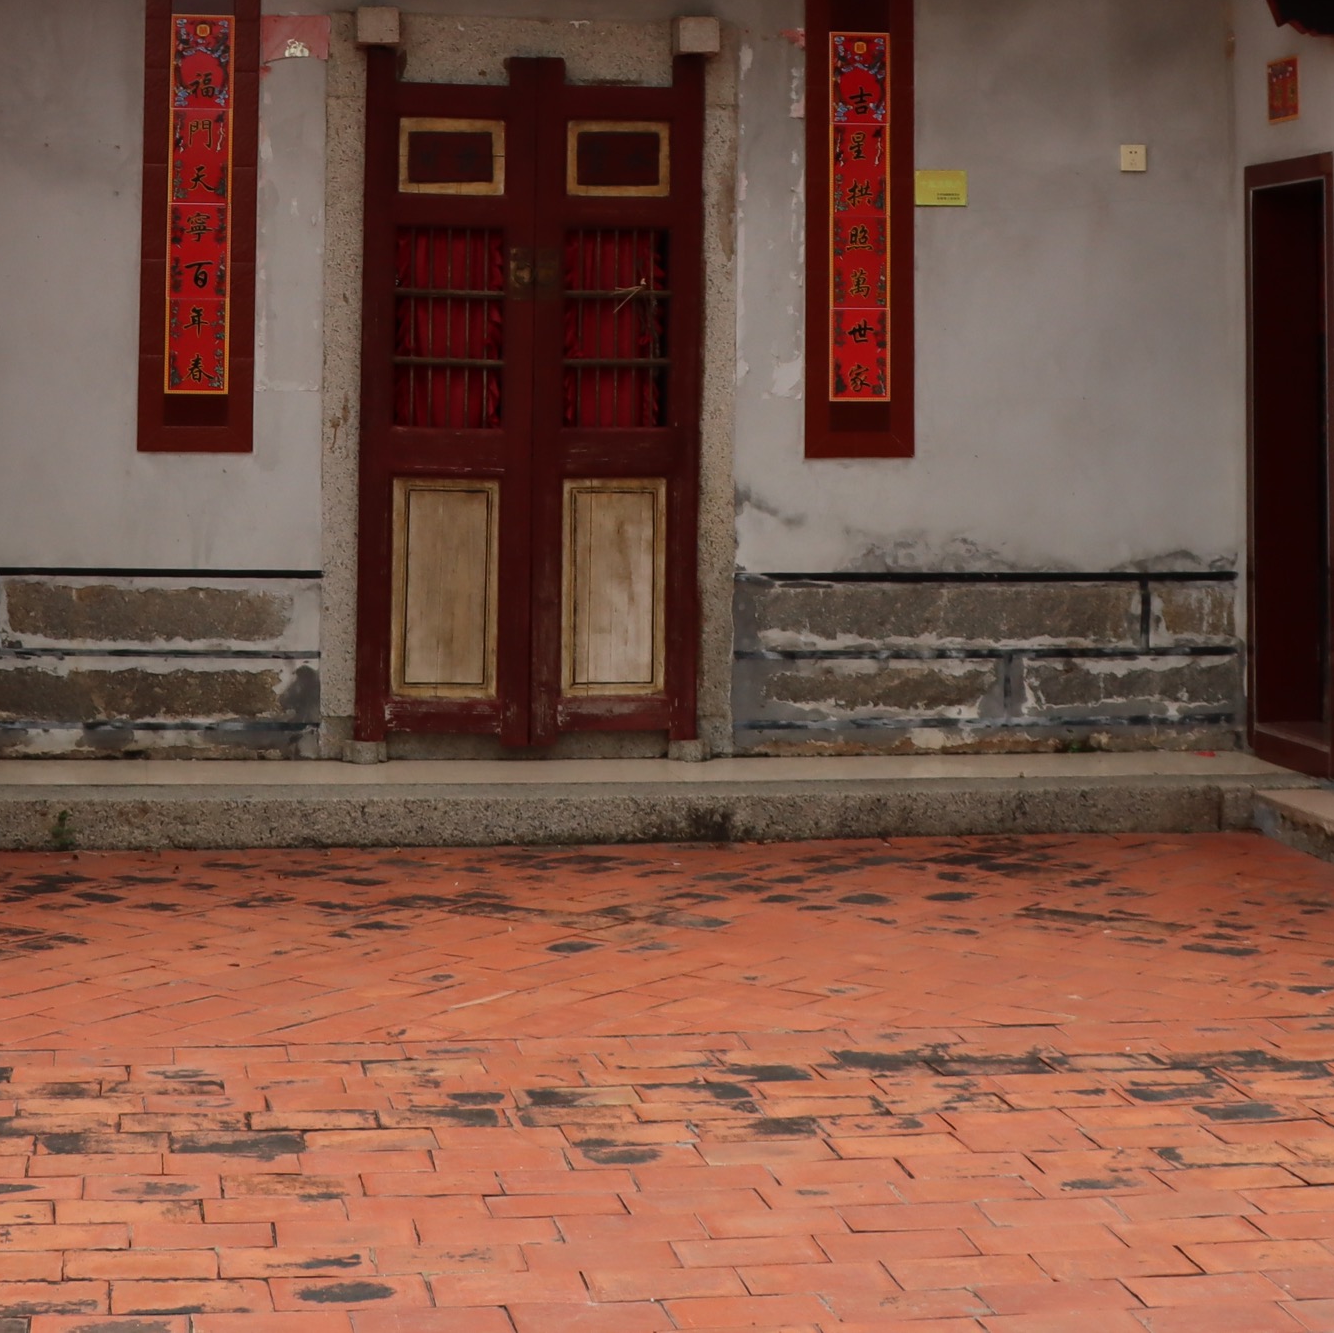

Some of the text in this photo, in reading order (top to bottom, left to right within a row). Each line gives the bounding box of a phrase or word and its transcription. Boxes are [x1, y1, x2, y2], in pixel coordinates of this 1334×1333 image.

[846, 86, 874, 393] 吉星拱照萬世家
